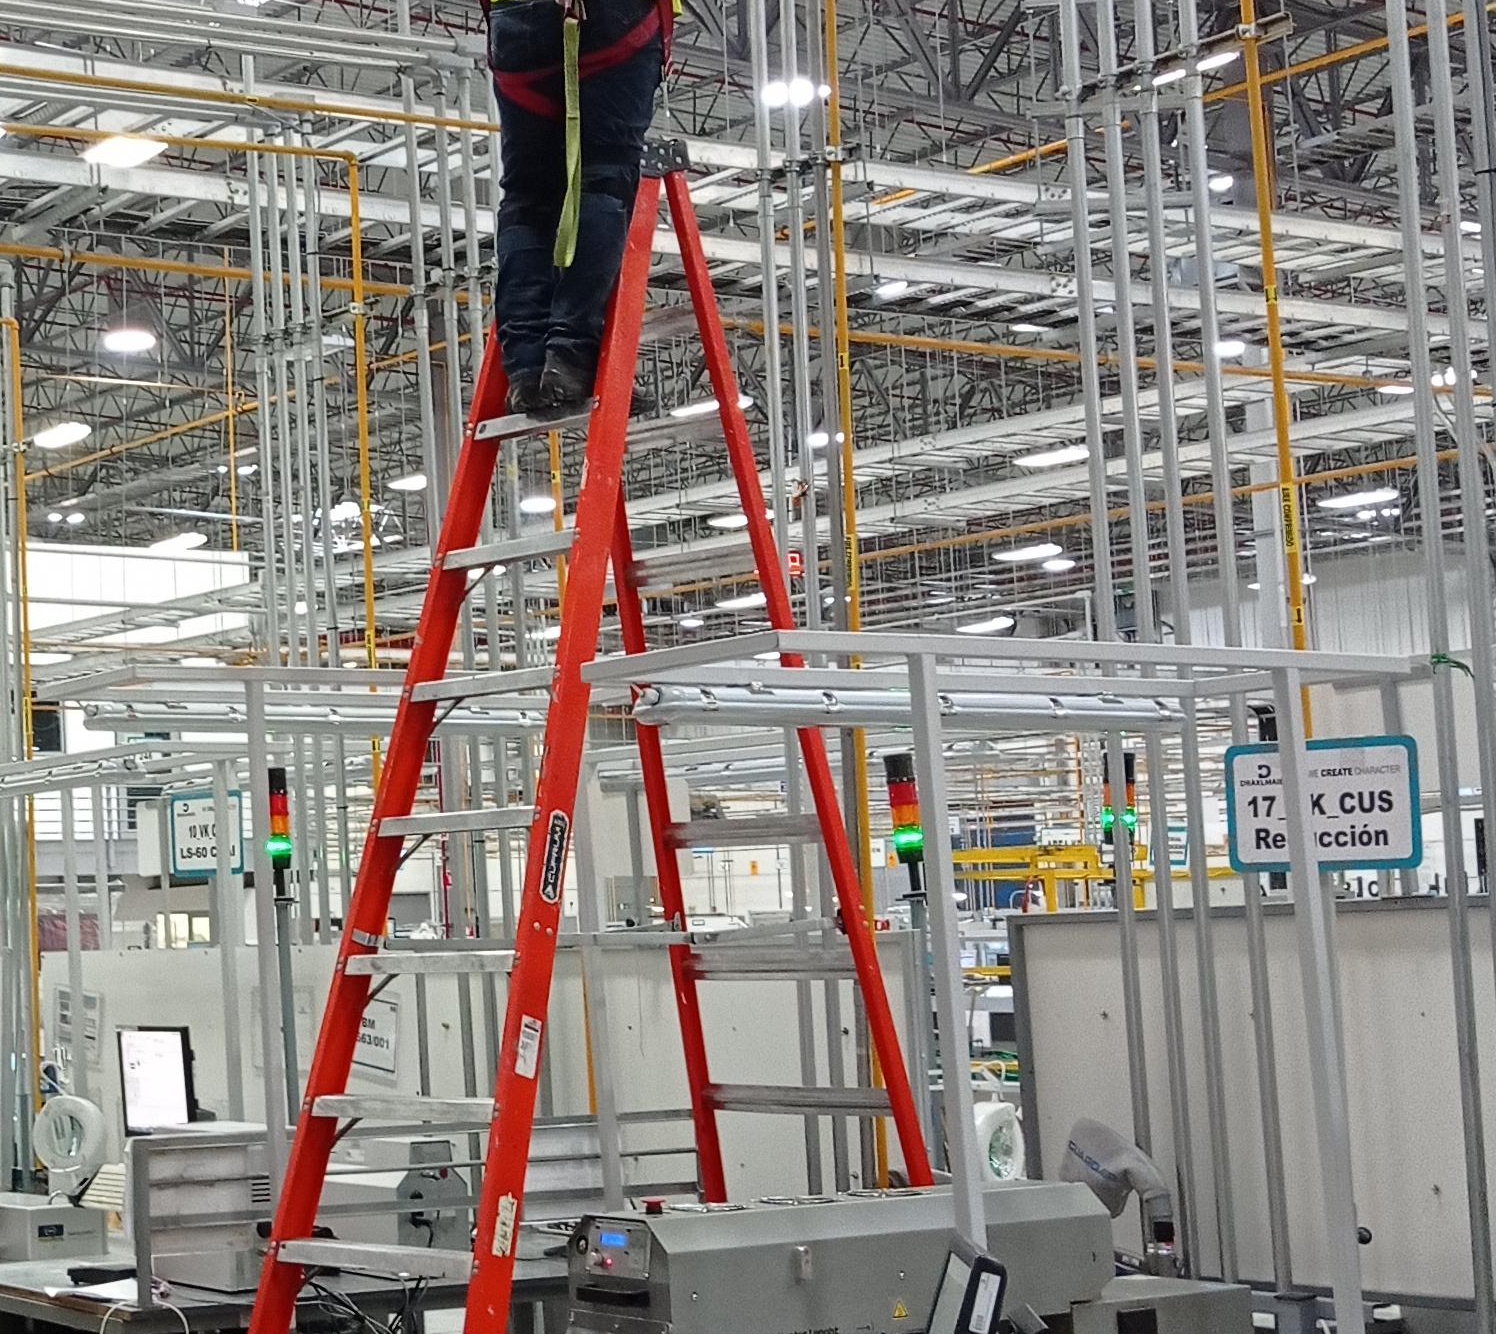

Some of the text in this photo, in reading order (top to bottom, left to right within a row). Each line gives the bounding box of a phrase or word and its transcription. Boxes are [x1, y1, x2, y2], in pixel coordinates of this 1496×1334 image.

[1321, 768, 1353, 777] CREATE
[1354, 765, 1401, 774] CHARACTER
[1247, 790, 1394, 820] 17_K_CUS
[1255, 824, 1389, 850] Rección
